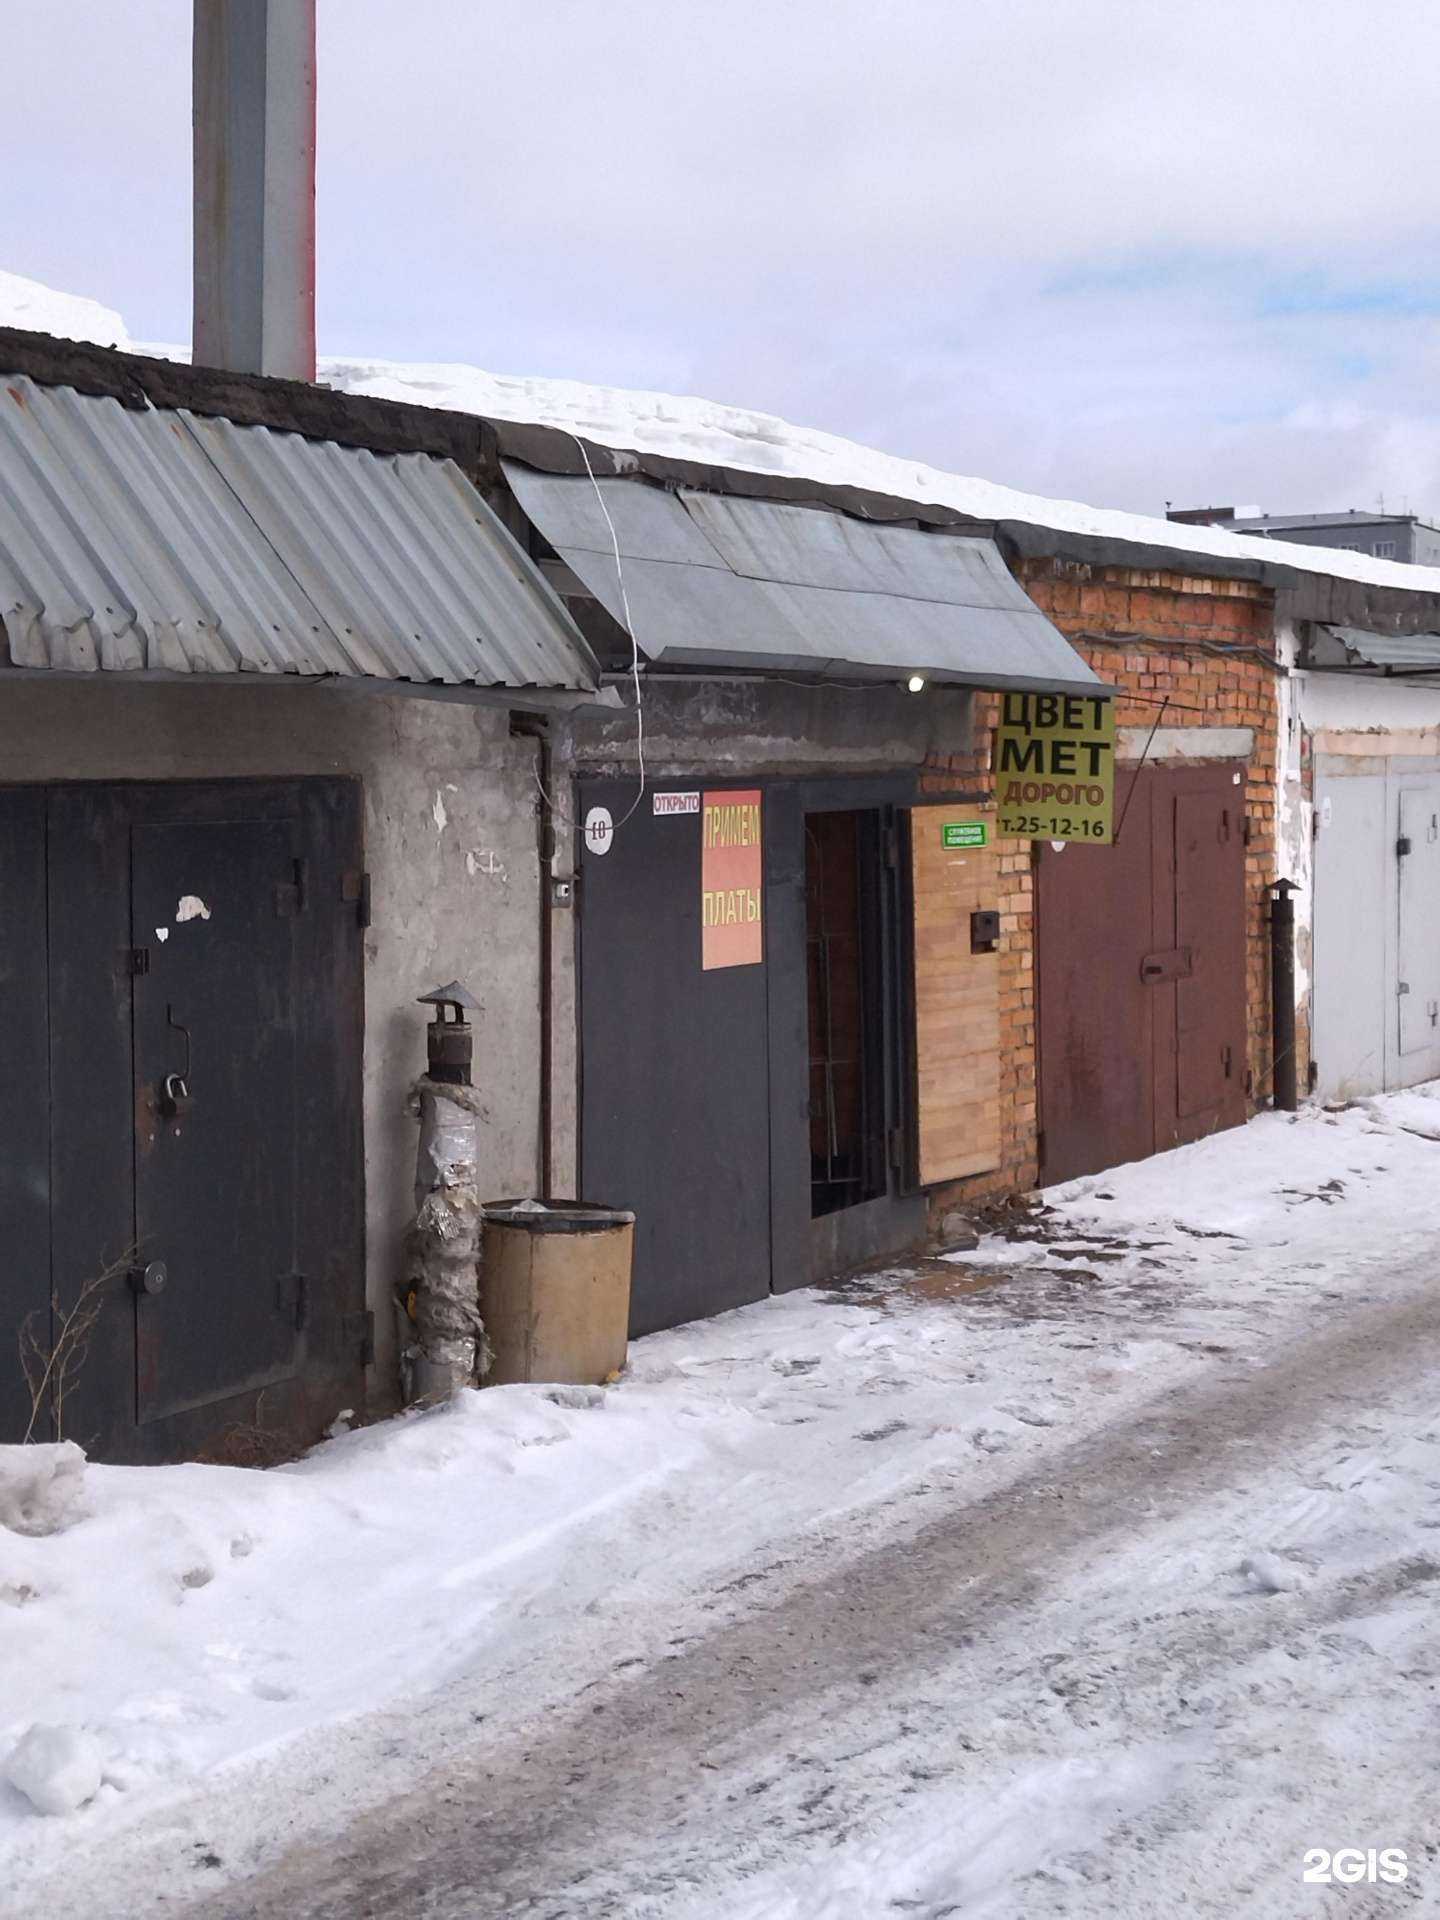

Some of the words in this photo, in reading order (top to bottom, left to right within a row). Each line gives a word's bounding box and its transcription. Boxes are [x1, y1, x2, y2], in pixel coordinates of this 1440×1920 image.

[1003, 693, 1111, 736] ЦВЕТ
[1001, 738, 1111, 777] МЕТ
[654, 795, 700, 812] ОТКРЫТО
[1003, 781, 1105, 807] ДОРОГО
[592, 820, 606, 840] 10
[1001, 816, 1105, 837] т.25-12-16
[703, 888, 761, 927] ПЛАТЫ
